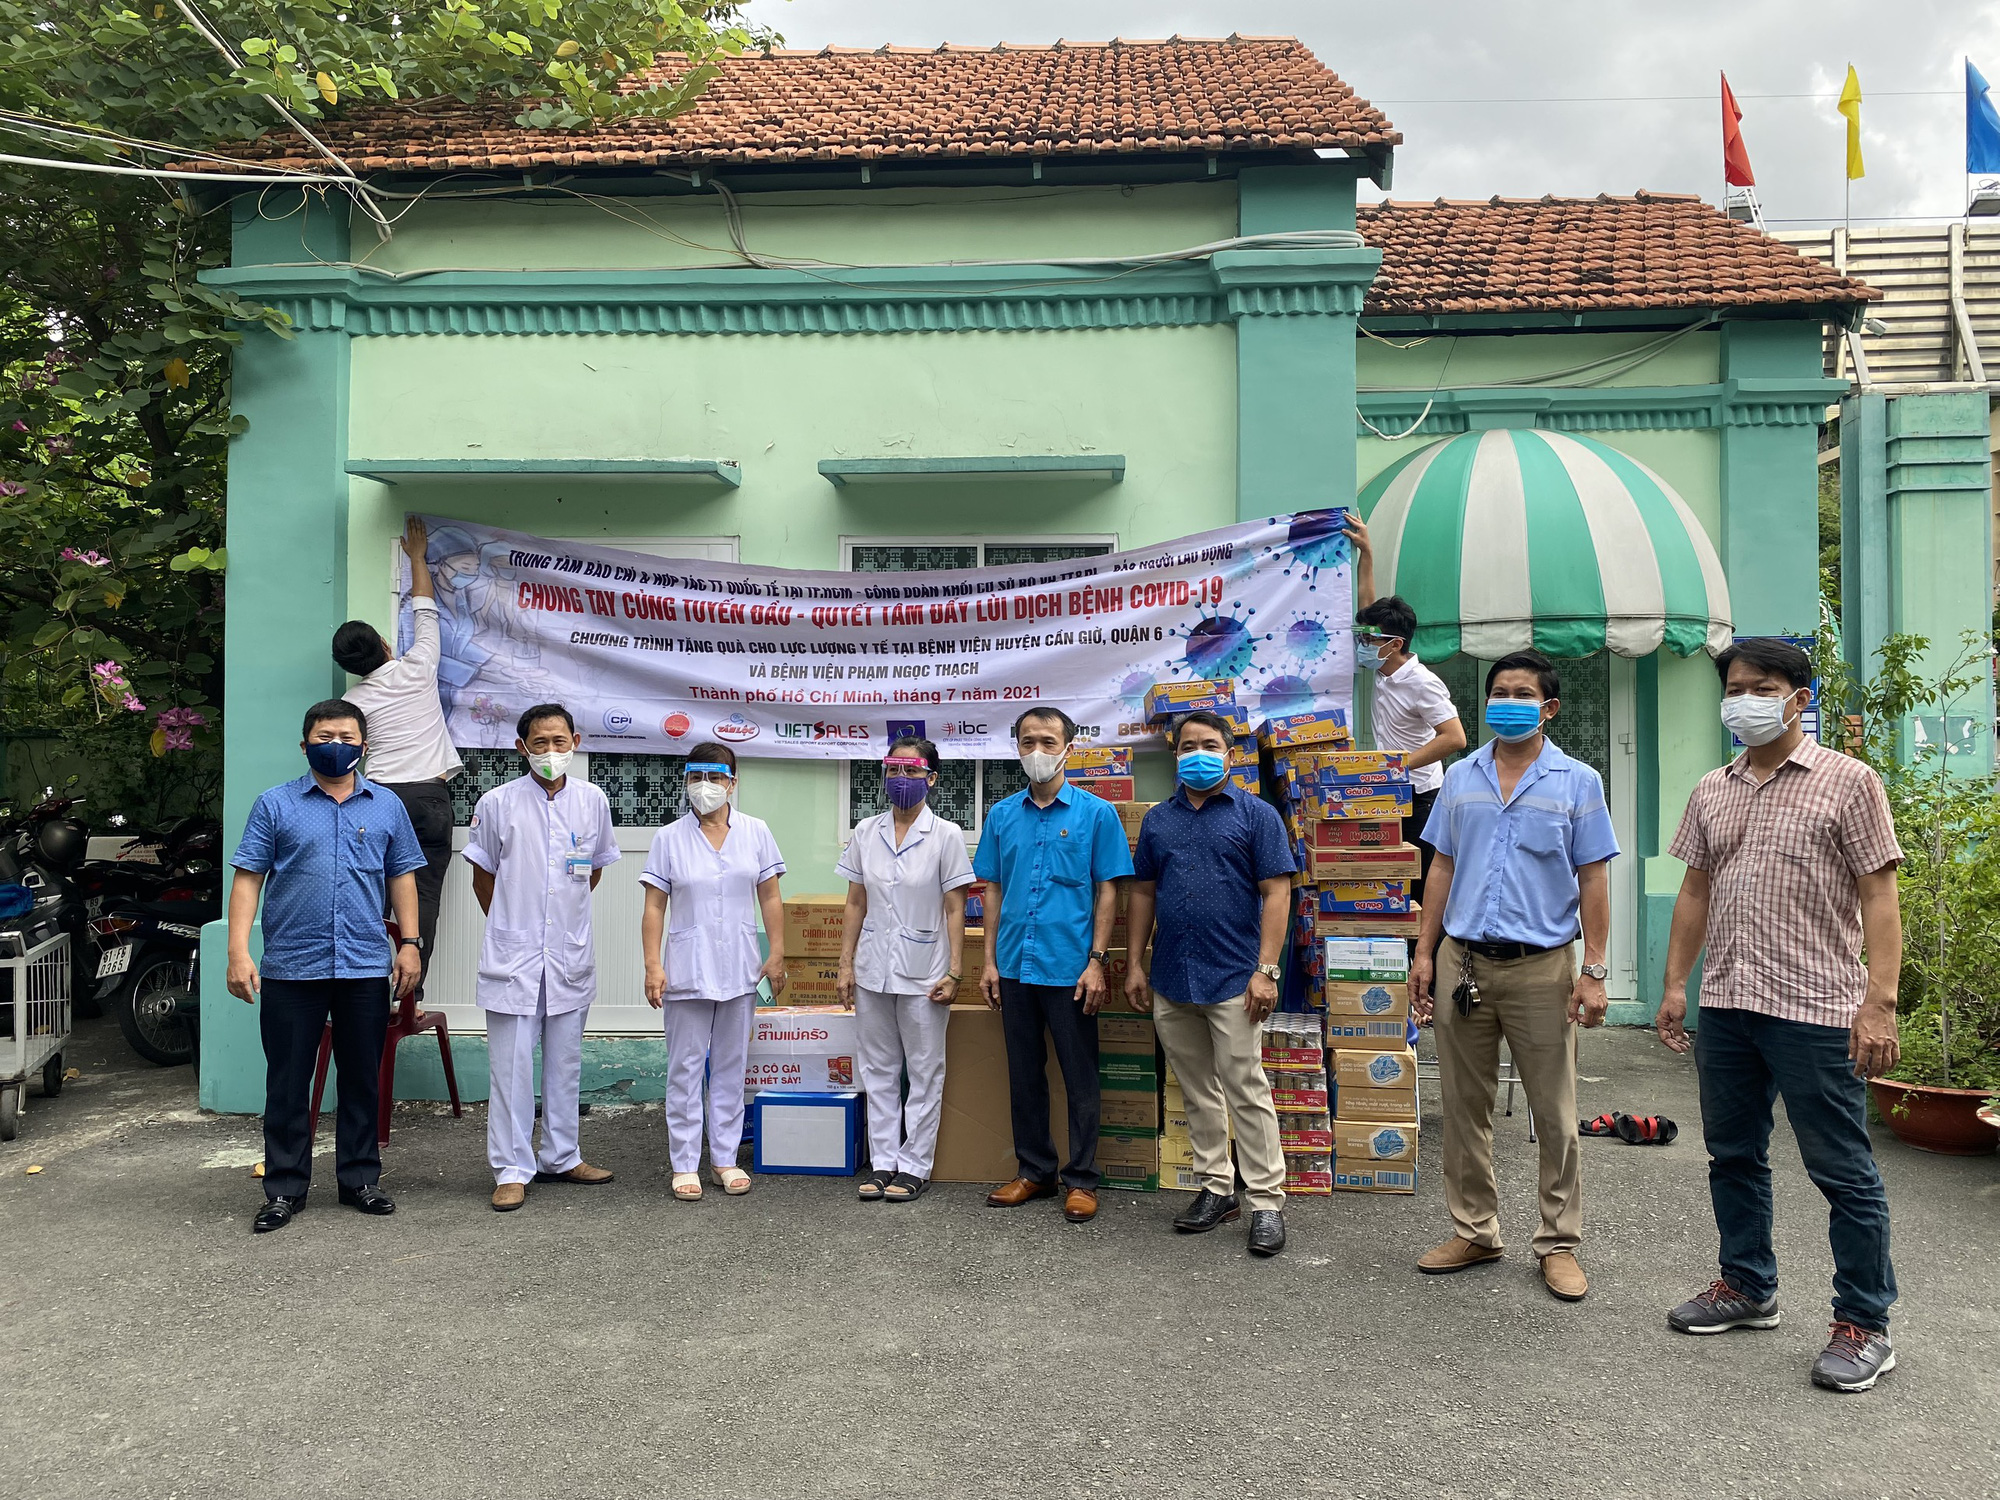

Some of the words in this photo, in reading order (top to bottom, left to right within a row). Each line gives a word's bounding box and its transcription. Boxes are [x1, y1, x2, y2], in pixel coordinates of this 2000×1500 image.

[509, 550, 552, 568] TRUNG
[553, 555, 583, 574] TÂM
[640, 571, 650, 584] &
[652, 573, 679, 588] HỢP
[680, 574, 707, 592] TÁC
[708, 580, 724, 592] TT
[728, 578, 761, 596] QUỐC
[764, 580, 780, 597] TẾ
[782, 586, 803, 600] TẠI
[805, 586, 852, 600] TP.HCM
[865, 584, 900, 600] CÔNG
[903, 583, 939, 599] ĐOÀN
[942, 580, 972, 596] KHỐI
[976, 581, 994, 594] CƠ
[998, 577, 1014, 591] SỞ
[518, 582, 584, 614] CHUNG
[585, 589, 616, 617] TAY
[622, 588, 677, 622] CÙNG
[682, 598, 746, 624] TUYẾN
[750, 600, 793, 626] ĐẦU
[812, 602, 875, 630] QUYẾT
[882, 602, 924, 626] TÂM
[976, 593, 1008, 622] LÙI
[1014, 593, 1062, 624] DỊCH
[1069, 584, 1123, 620] BỆNH
[1130, 576, 1224, 610] COVID-19
[570, 631, 629, 648] CHƯƠNG
[633, 634, 674, 652] TRÌNH
[678, 638, 712, 656] TẶNG
[716, 638, 746, 655] QUÀ
[748, 642, 777, 654] CHO
[780, 642, 808, 657] LỰC
[810, 642, 856, 657] LƯỢNG
[859, 643, 868, 654] Y
[872, 639, 888, 654] TẾ
[892, 642, 915, 658] TẠI
[918, 637, 956, 657] BỆNH
[960, 636, 992, 655] VIỆN
[995, 634, 1041, 652] HUYỆN
[1045, 629, 1074, 647] CẦN
[1078, 626, 1106, 646] GIỜ,
[1111, 625, 1150, 646] QUẬN
[1154, 626, 1163, 640] 6
[750, 662, 767, 678] VÀ
[771, 662, 808, 682] BỆNH
[812, 663, 844, 682] VIỆN
[848, 666, 889, 682] PHẠM
[892, 664, 930, 680] NGỌC
[934, 662, 979, 678] THẠCH
[689, 686, 740, 701] Thành
[745, 688, 778, 704] phố
[782, 688, 805, 702] Hồ
[810, 690, 838, 704] Chí
[843, 690, 888, 705] Minh,
[894, 688, 941, 704] tháng
[946, 688, 956, 701] 7
[962, 687, 998, 700] năm
[1003, 685, 1040, 700] 2021
[611, 716, 632, 724] CPI
[775, 720, 870, 740] VIETSALES
[958, 720, 988, 734] ibc
[1350, 830, 1390, 842] KOKOMI
[802, 928, 826, 938] CHANH
[100, 960, 123, 976] 0365
[818, 969, 838, 979] TẤN
[792, 982, 814, 990] CHANH
[816, 980, 834, 991] MUỐI
[757, 1028, 828, 1040] สามแม่ครัว
[752, 1065, 759, 1074] 3
[762, 1062, 778, 1074] CÔ
[782, 1062, 801, 1074] GÁI
[760, 1074, 778, 1085] HẾT
